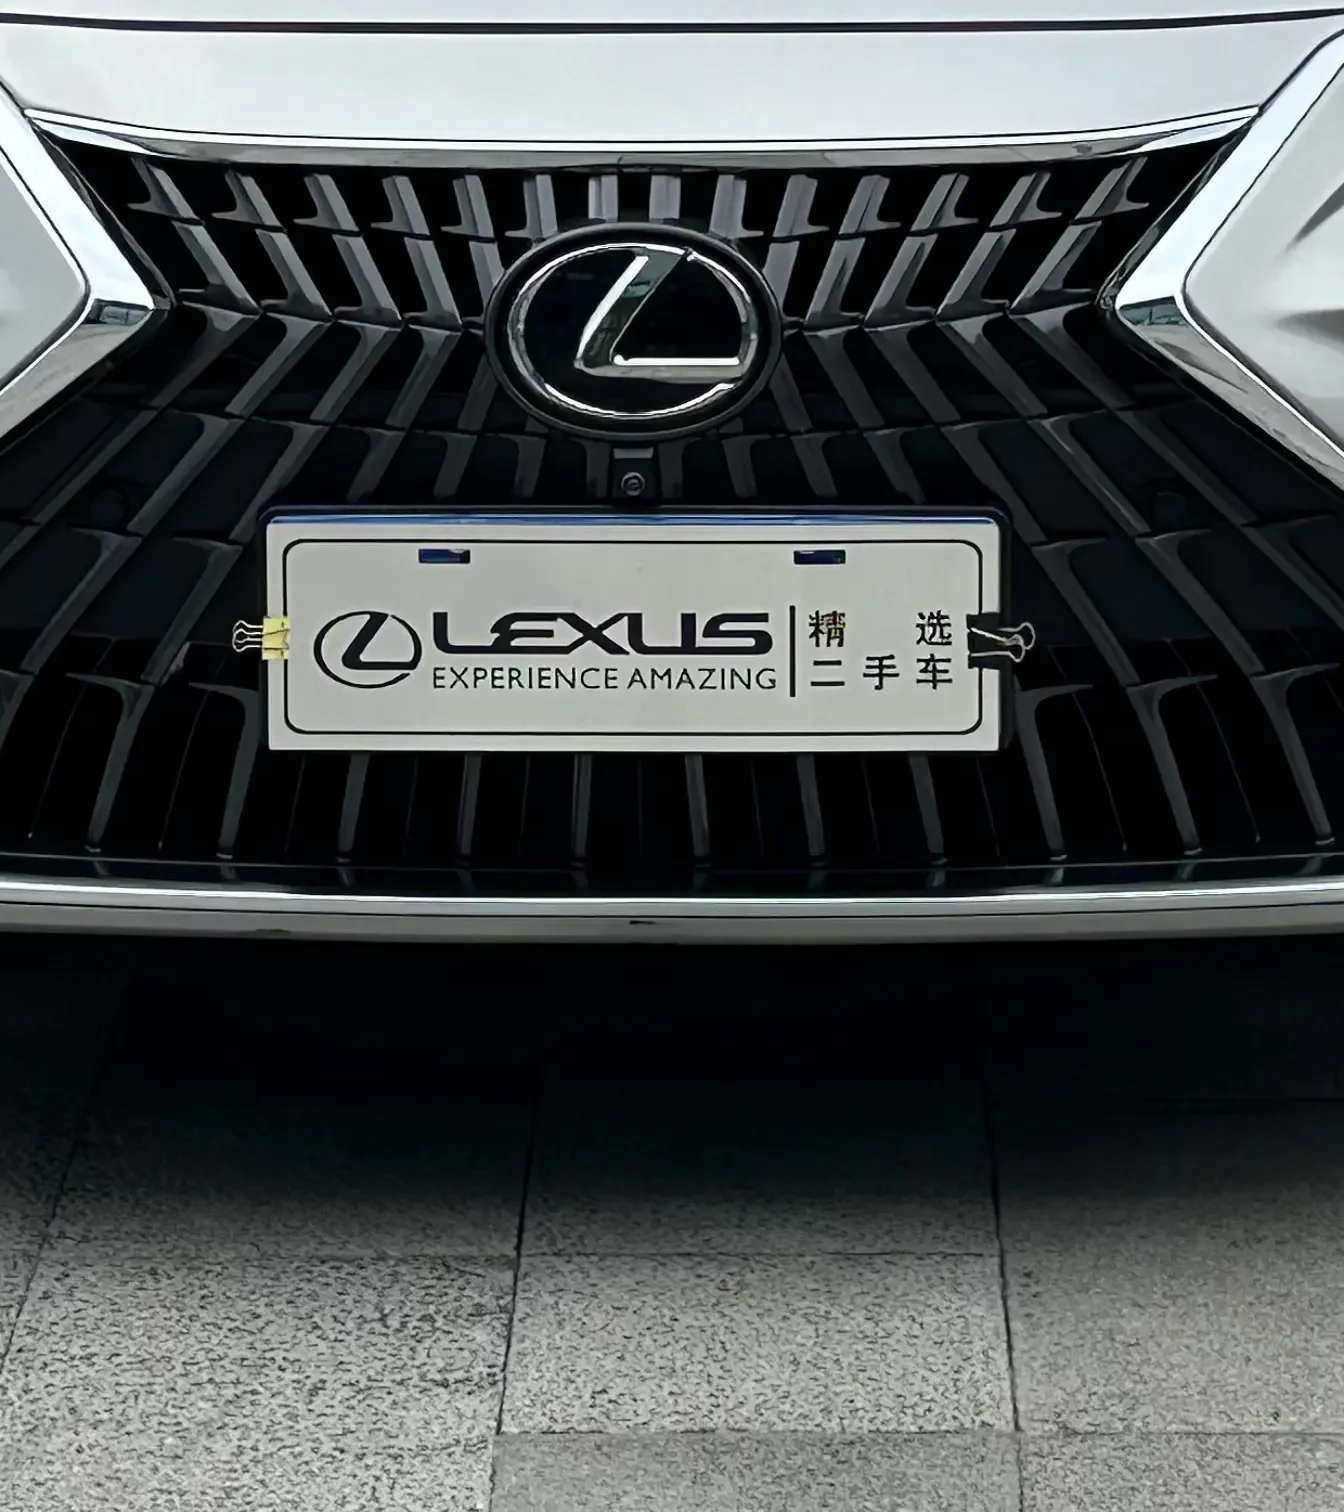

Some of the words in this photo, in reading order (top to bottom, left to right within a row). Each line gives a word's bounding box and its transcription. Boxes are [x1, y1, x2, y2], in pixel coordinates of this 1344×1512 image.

[431, 611, 774, 656] LEXUS
[432, 666, 619, 690] EXPERIENCE
[626, 666, 778, 691] AMAZING
[810, 653, 954, 691] 二手车
